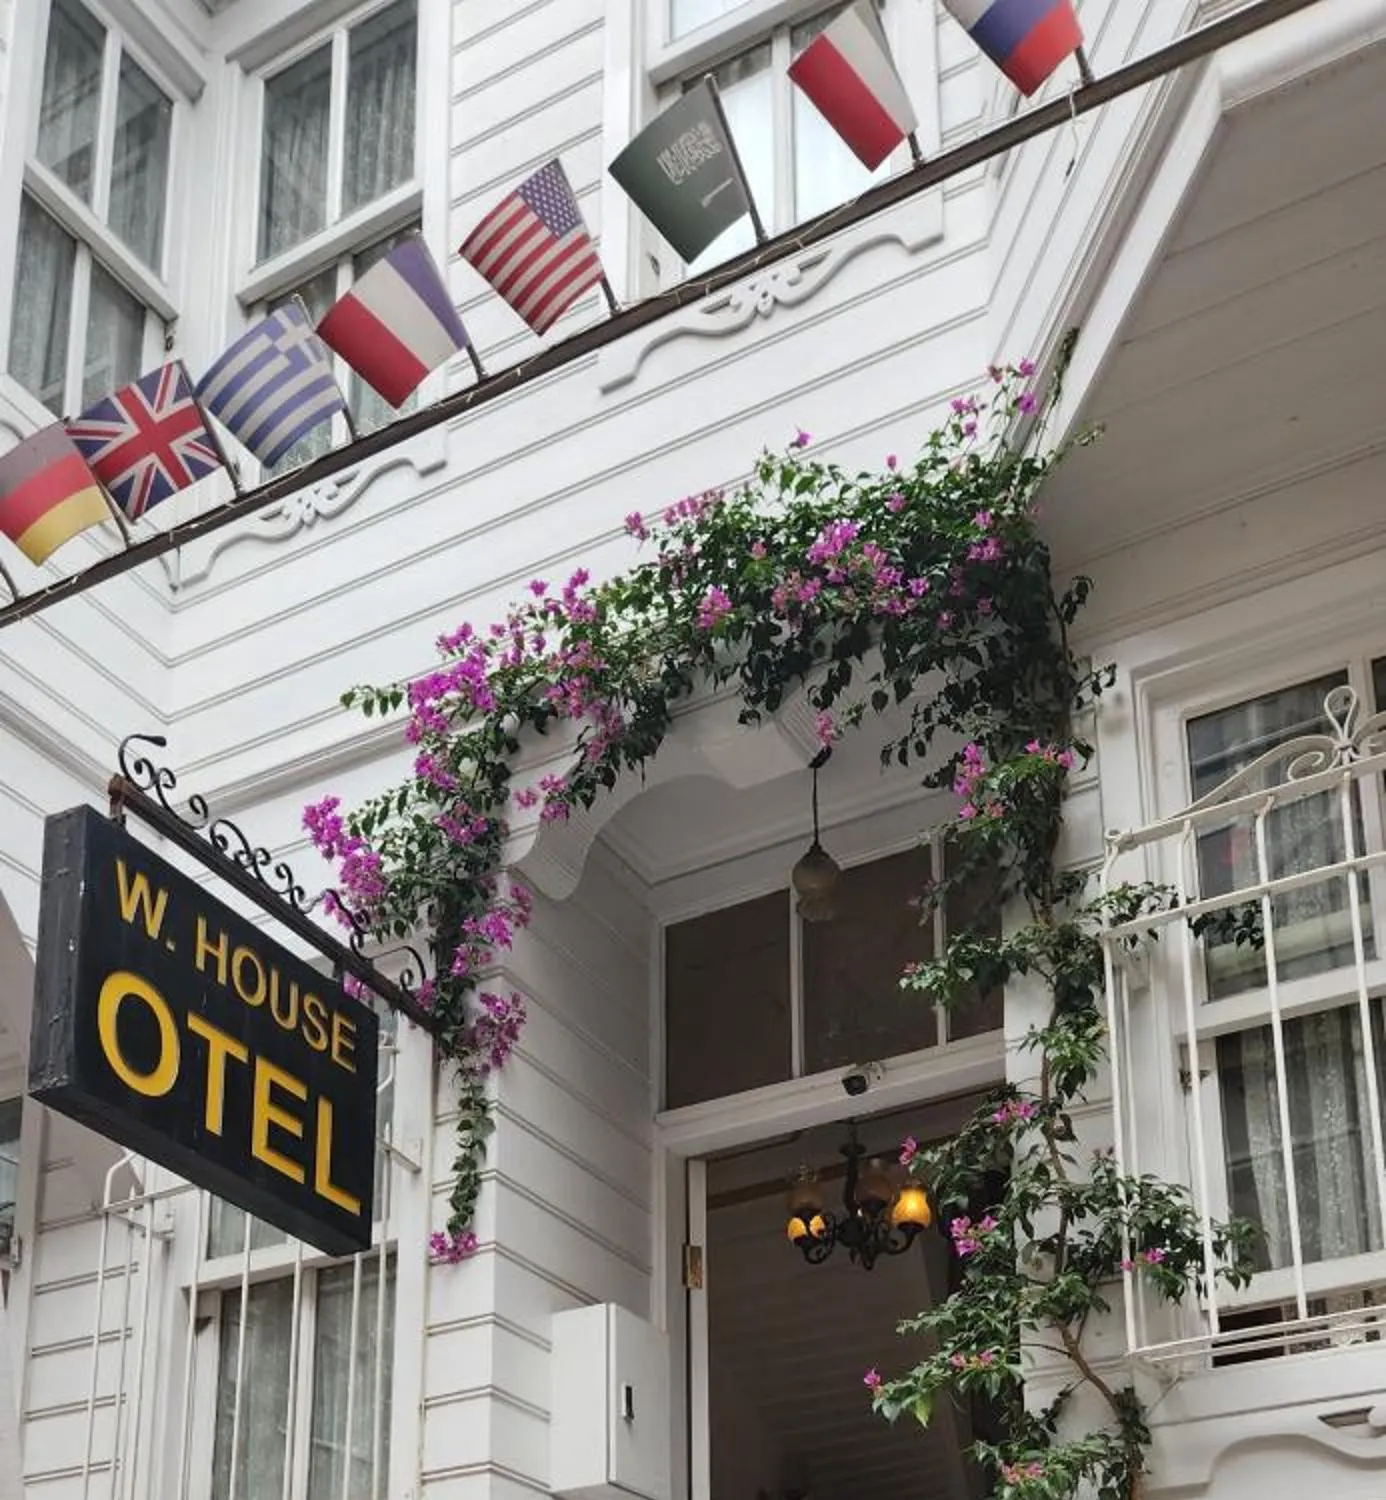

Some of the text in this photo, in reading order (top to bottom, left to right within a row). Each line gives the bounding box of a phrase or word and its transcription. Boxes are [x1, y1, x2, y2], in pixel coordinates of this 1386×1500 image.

[115, 859, 357, 1073] W. HOUSE
[97, 970, 361, 1216] OTEL
